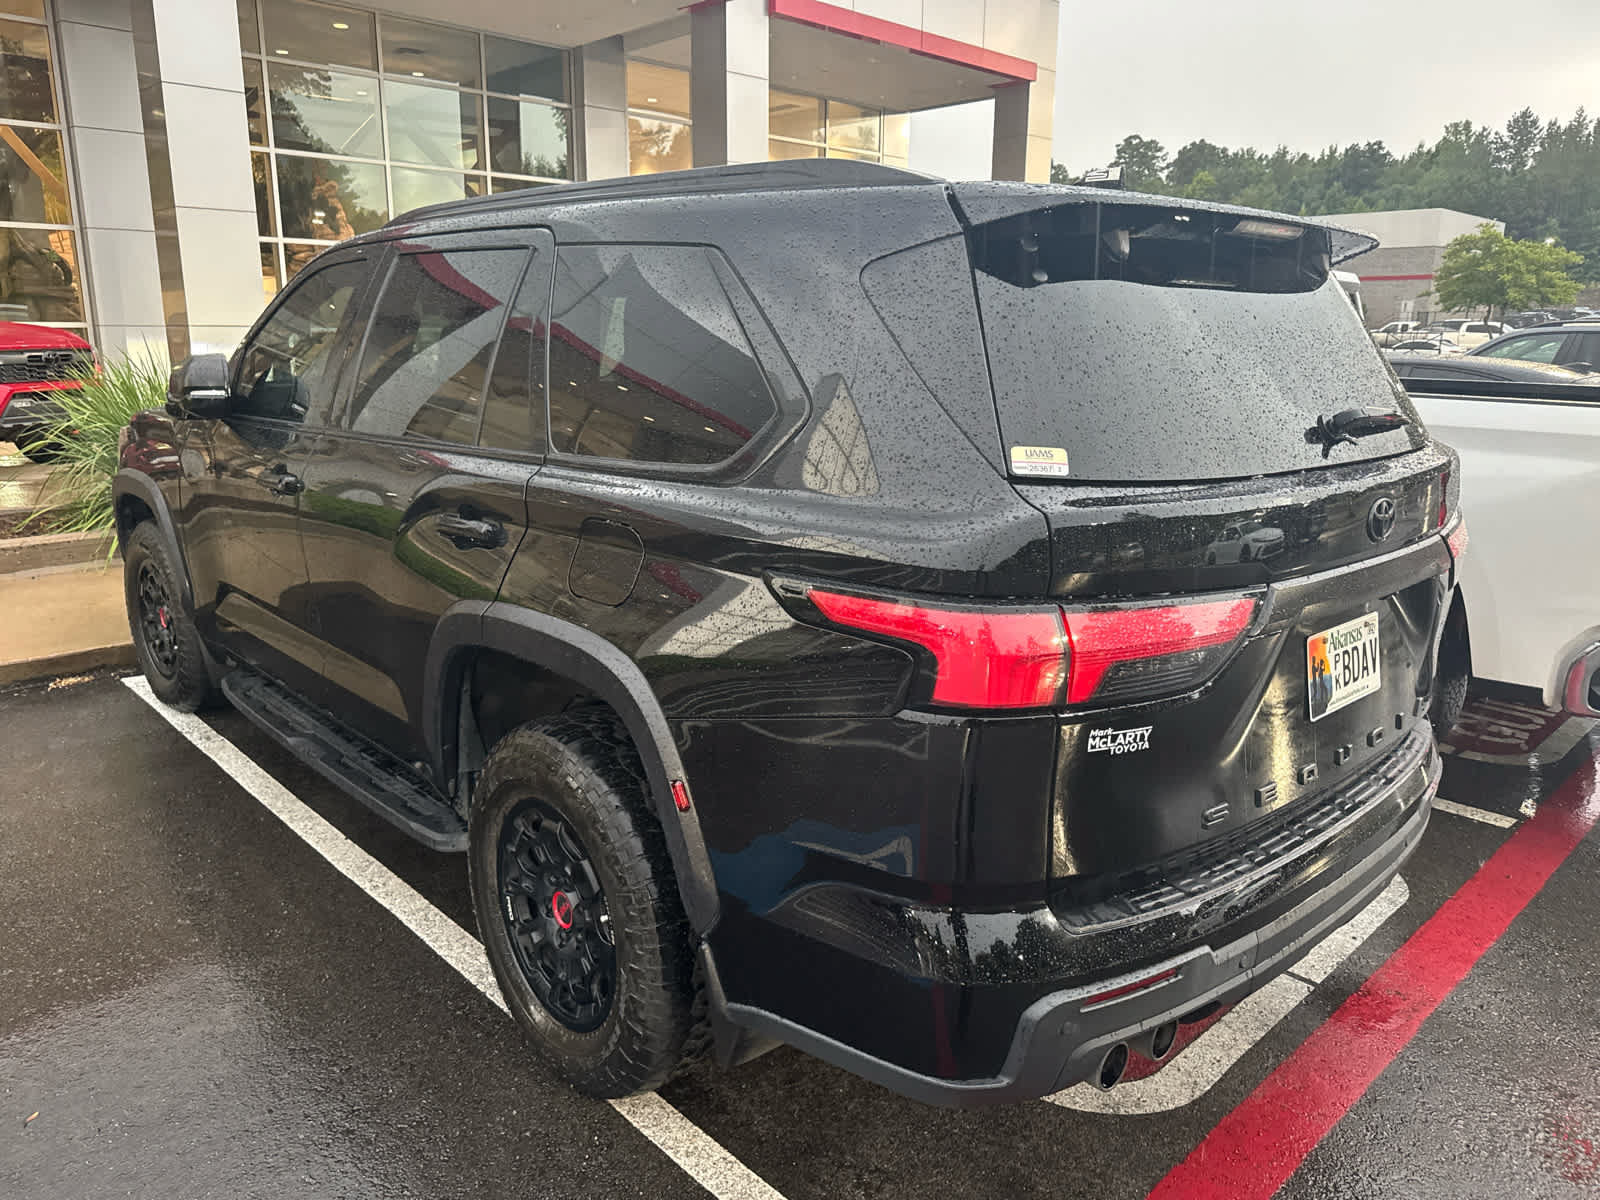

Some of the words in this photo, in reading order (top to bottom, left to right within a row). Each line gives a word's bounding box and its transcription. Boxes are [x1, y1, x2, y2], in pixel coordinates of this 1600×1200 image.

[1328, 625, 1363, 654] Arkansas
[1342, 637, 1378, 688] BDAV
[1088, 728, 1152, 750] McLARTY
[1089, 727, 1113, 738] Mark
[1110, 741, 1149, 755] TOYOTA
[1202, 696, 1424, 830] SEQUOIA
